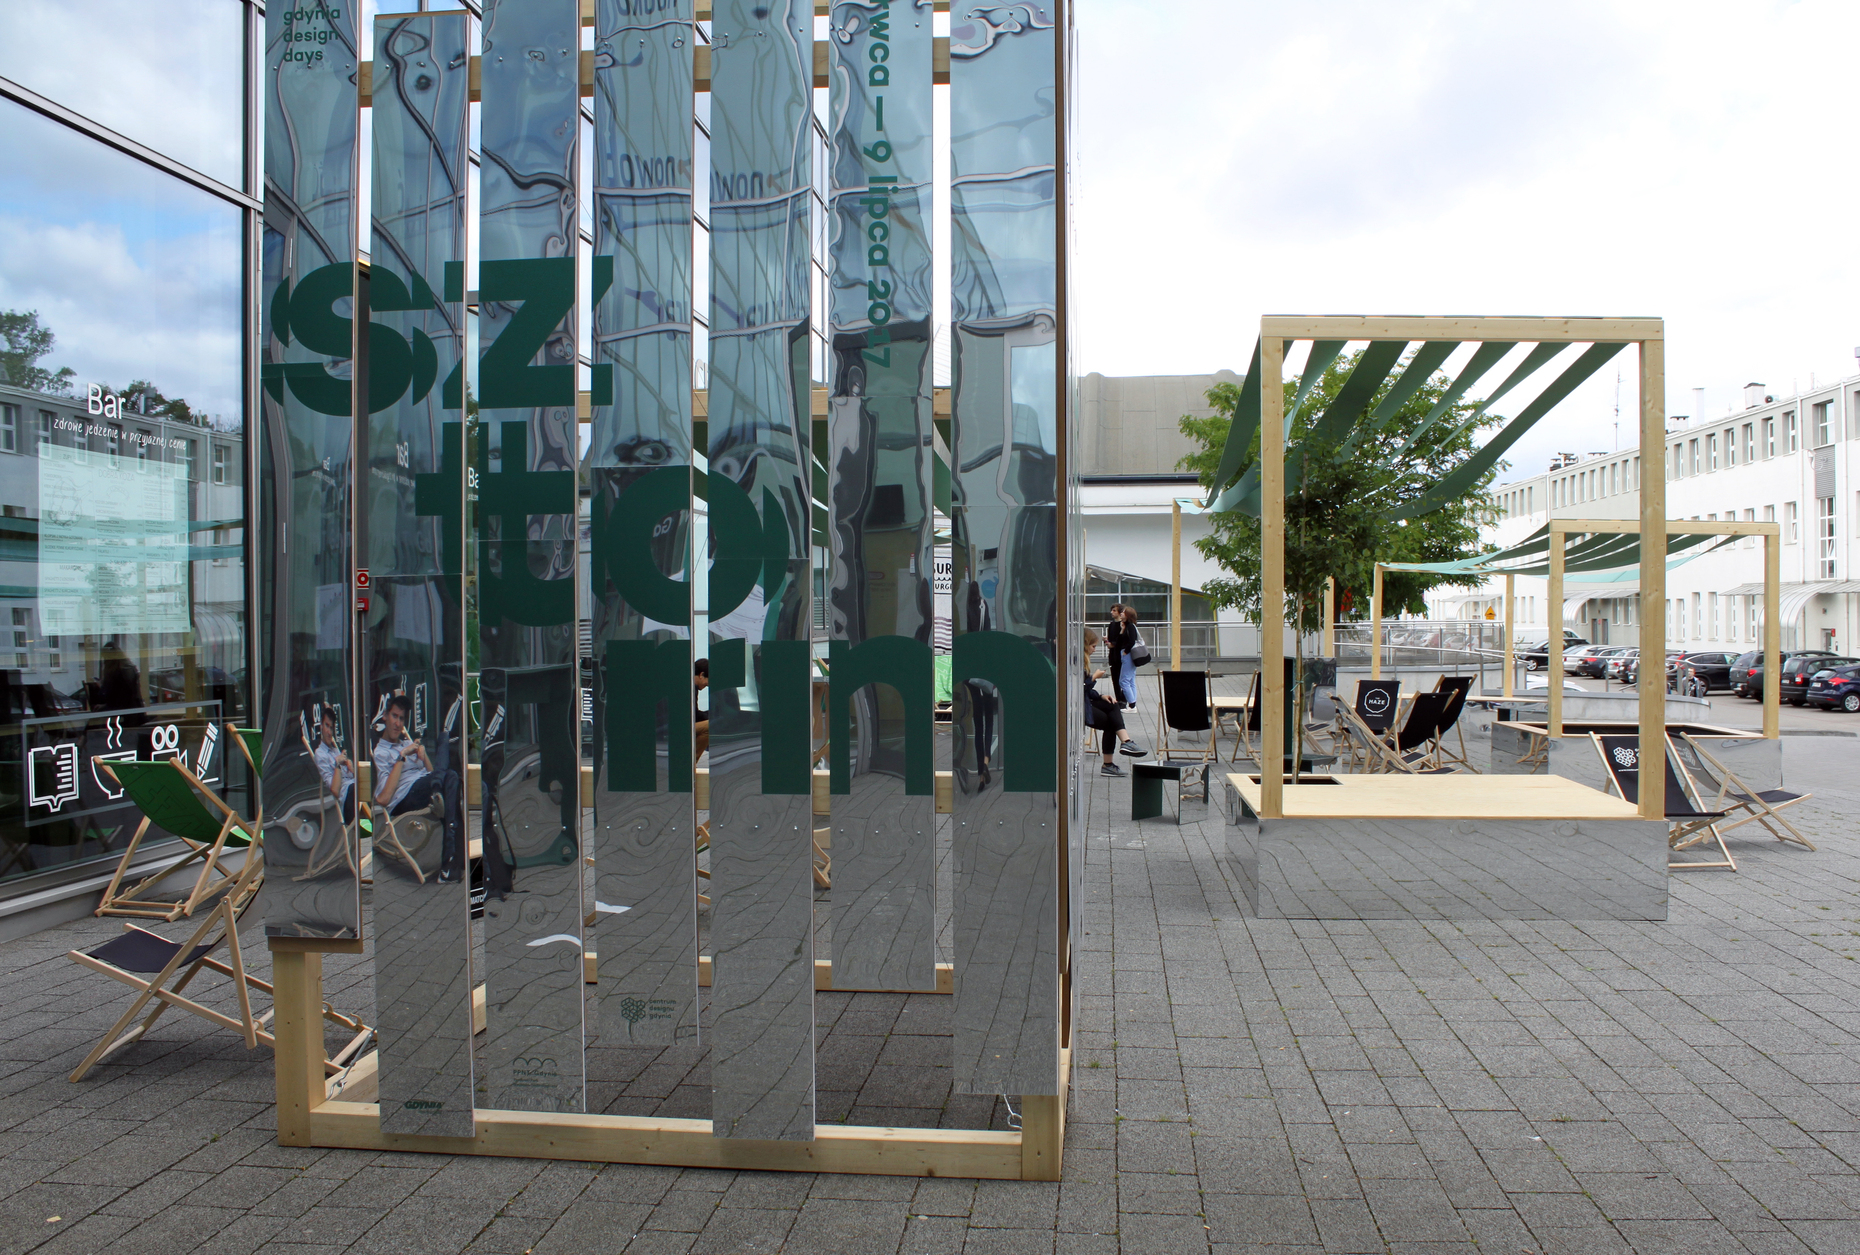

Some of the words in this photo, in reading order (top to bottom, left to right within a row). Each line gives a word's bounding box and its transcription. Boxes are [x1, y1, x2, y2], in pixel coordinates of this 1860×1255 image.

[283, 5, 341, 26] gdynia
[283, 27, 339, 45] design
[283, 48, 324, 65] days
[863, 140, 892, 163] 9
[860, 175, 899, 267] lipca
[862, 279, 891, 369] 2017
[87, 382, 126, 420] Bar
[53, 417, 83, 433] zdrowe
[85, 423, 119, 440] jedzenie
[121, 430, 127, 440] w
[168, 438, 187, 451] cenie
[934, 562, 952, 575] UR
